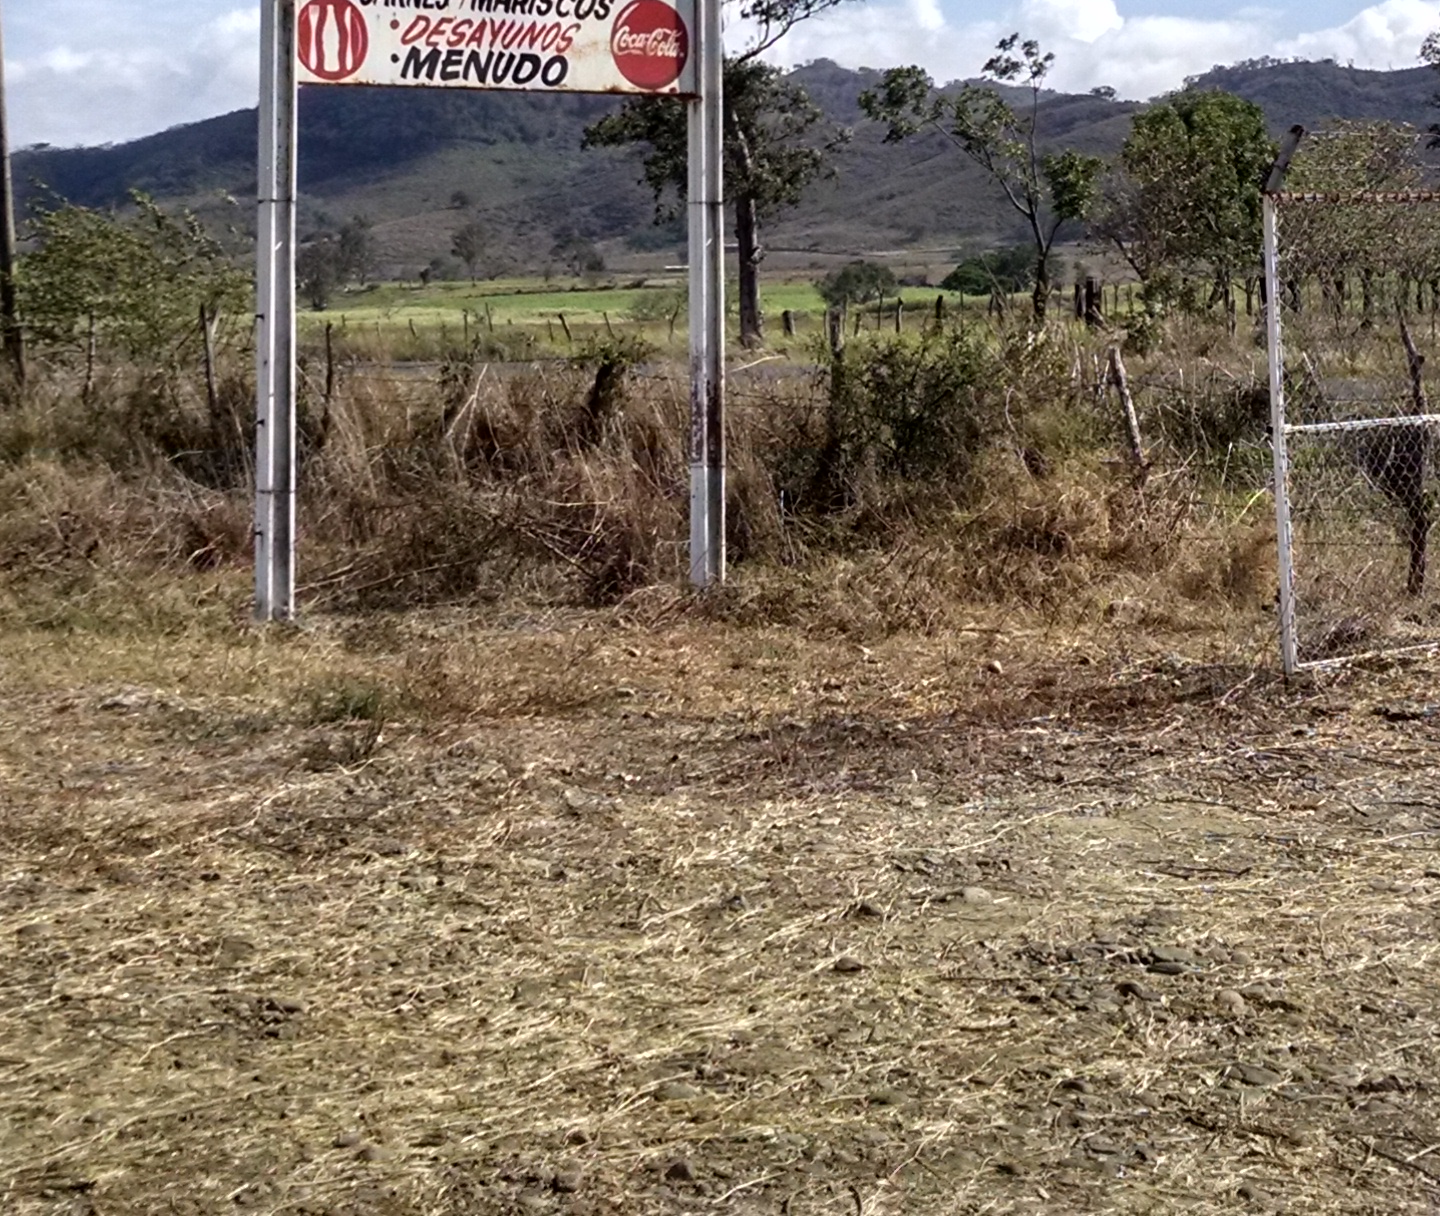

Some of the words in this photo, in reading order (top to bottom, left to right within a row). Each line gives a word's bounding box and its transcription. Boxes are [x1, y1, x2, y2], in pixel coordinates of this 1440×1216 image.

[400, 14, 582, 54] DESAYUNOS
[612, 25, 682, 57] Coca-Cola
[400, 45, 569, 87] MENUDO
